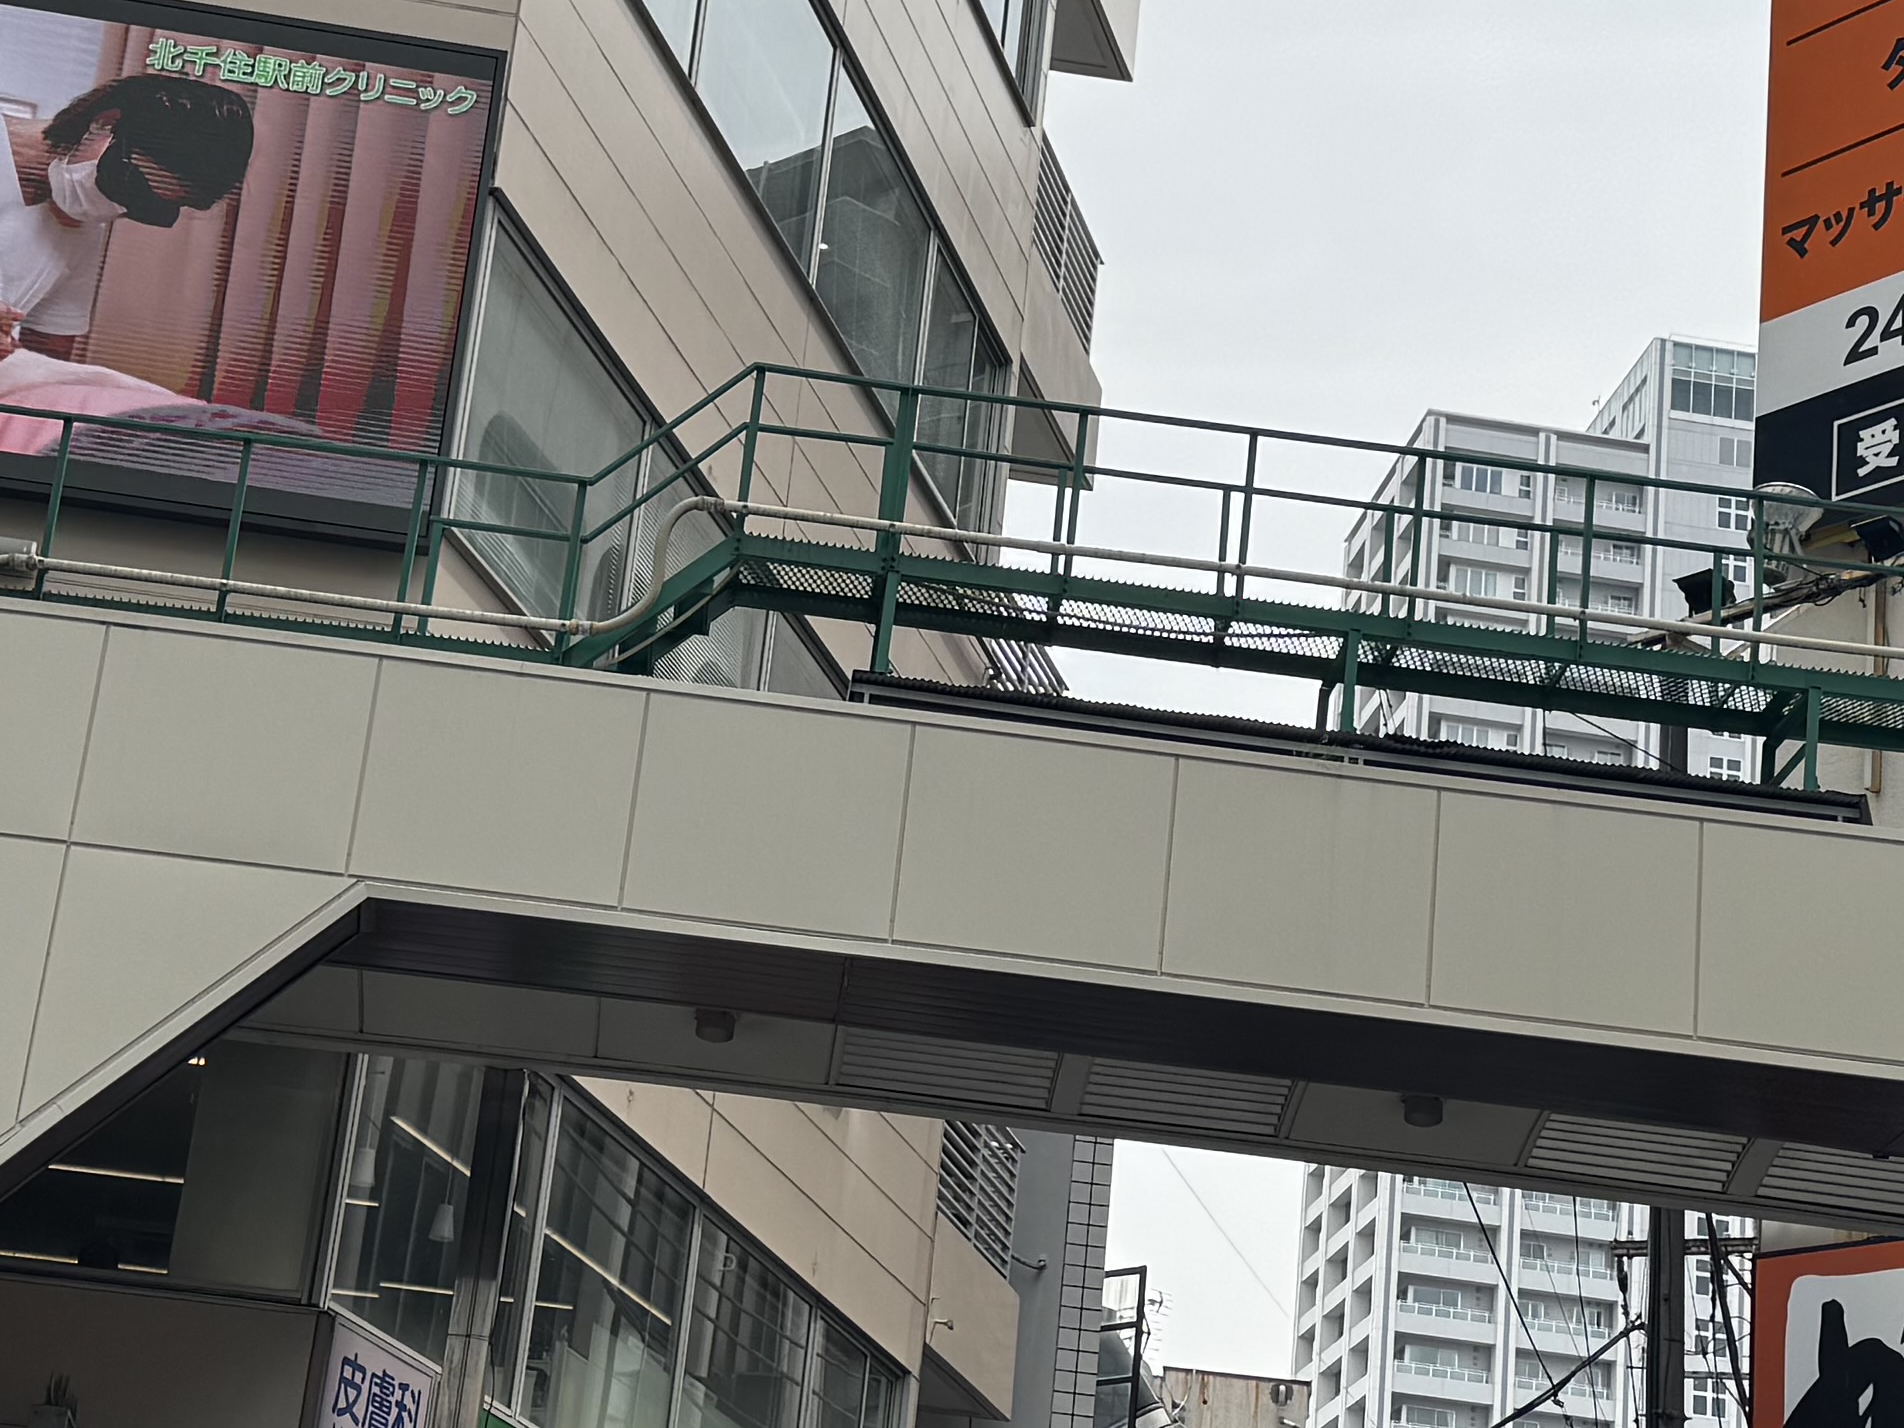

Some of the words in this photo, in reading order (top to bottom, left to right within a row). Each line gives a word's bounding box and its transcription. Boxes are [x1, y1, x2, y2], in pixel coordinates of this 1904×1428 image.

[146, 37, 478, 117] 北千住駅前クリニック
